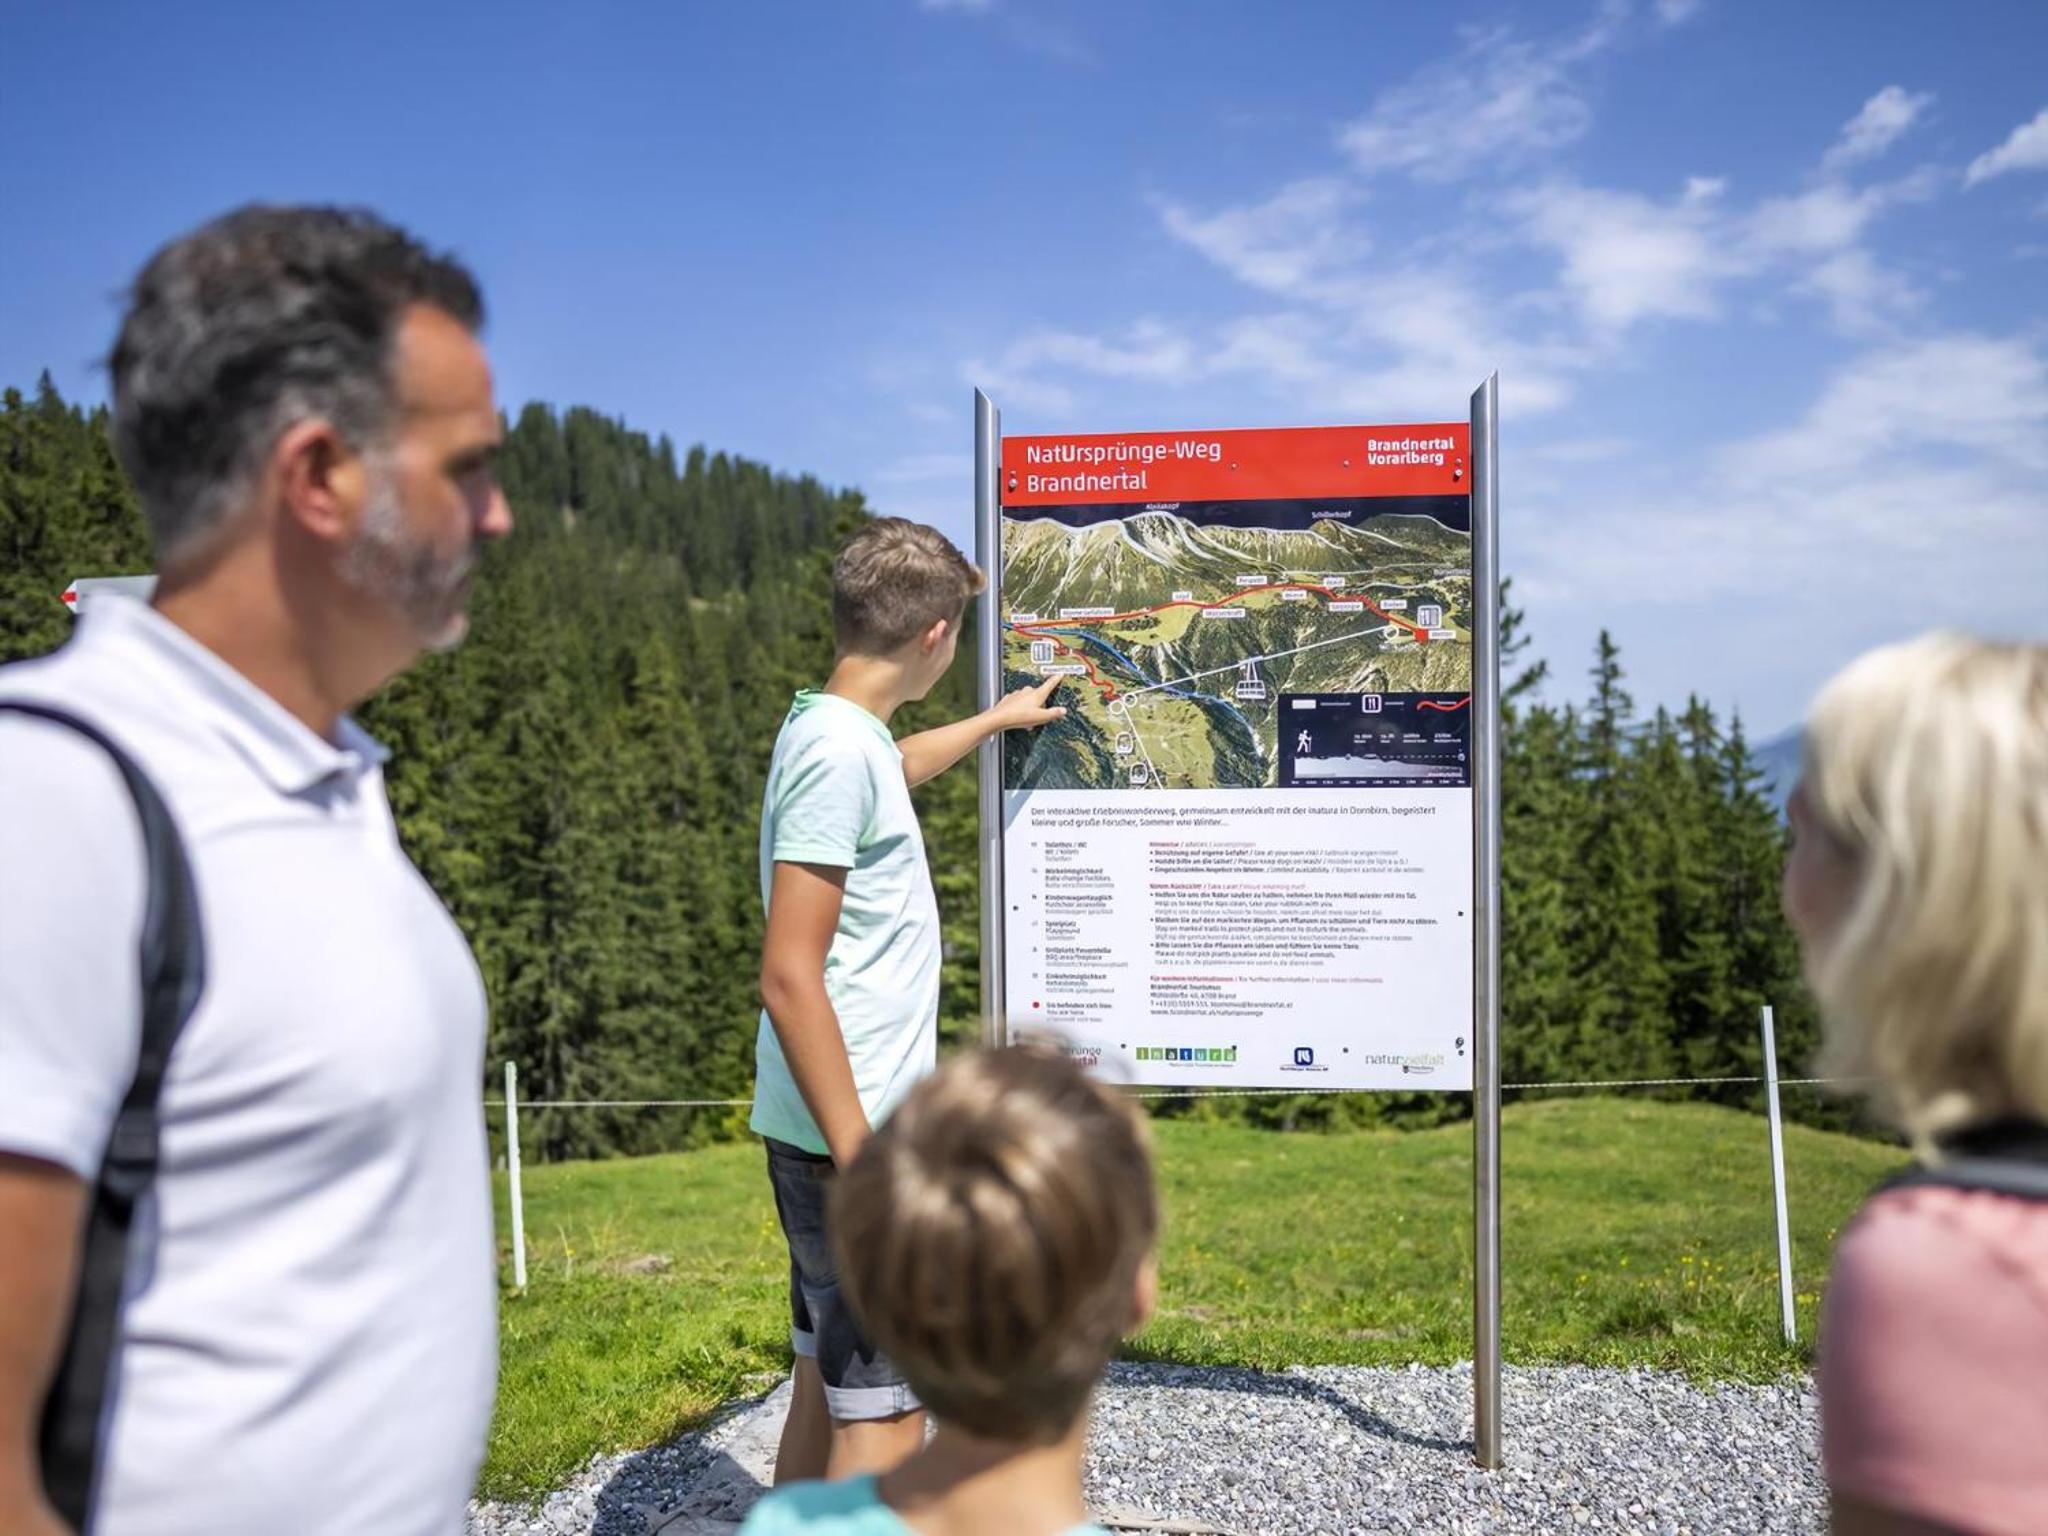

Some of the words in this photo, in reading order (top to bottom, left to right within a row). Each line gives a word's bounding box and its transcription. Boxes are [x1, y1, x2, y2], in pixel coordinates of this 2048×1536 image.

[1367, 436, 1454, 451] Brandnertal
[1026, 441, 1222, 465] NatUrsprünge-Weg
[1367, 452, 1444, 465] Vorarlberg
[1027, 471, 1148, 493] Brandnertal
[1031, 807, 1045, 817] Der
[1179, 807, 1229, 817] gemeinsam
[1276, 807, 1290, 816] mit
[1292, 807, 1306, 816] der
[1340, 807, 1348, 816] in
[1058, 818, 1074, 827] und
[1137, 1047, 1236, 1061] inatura
